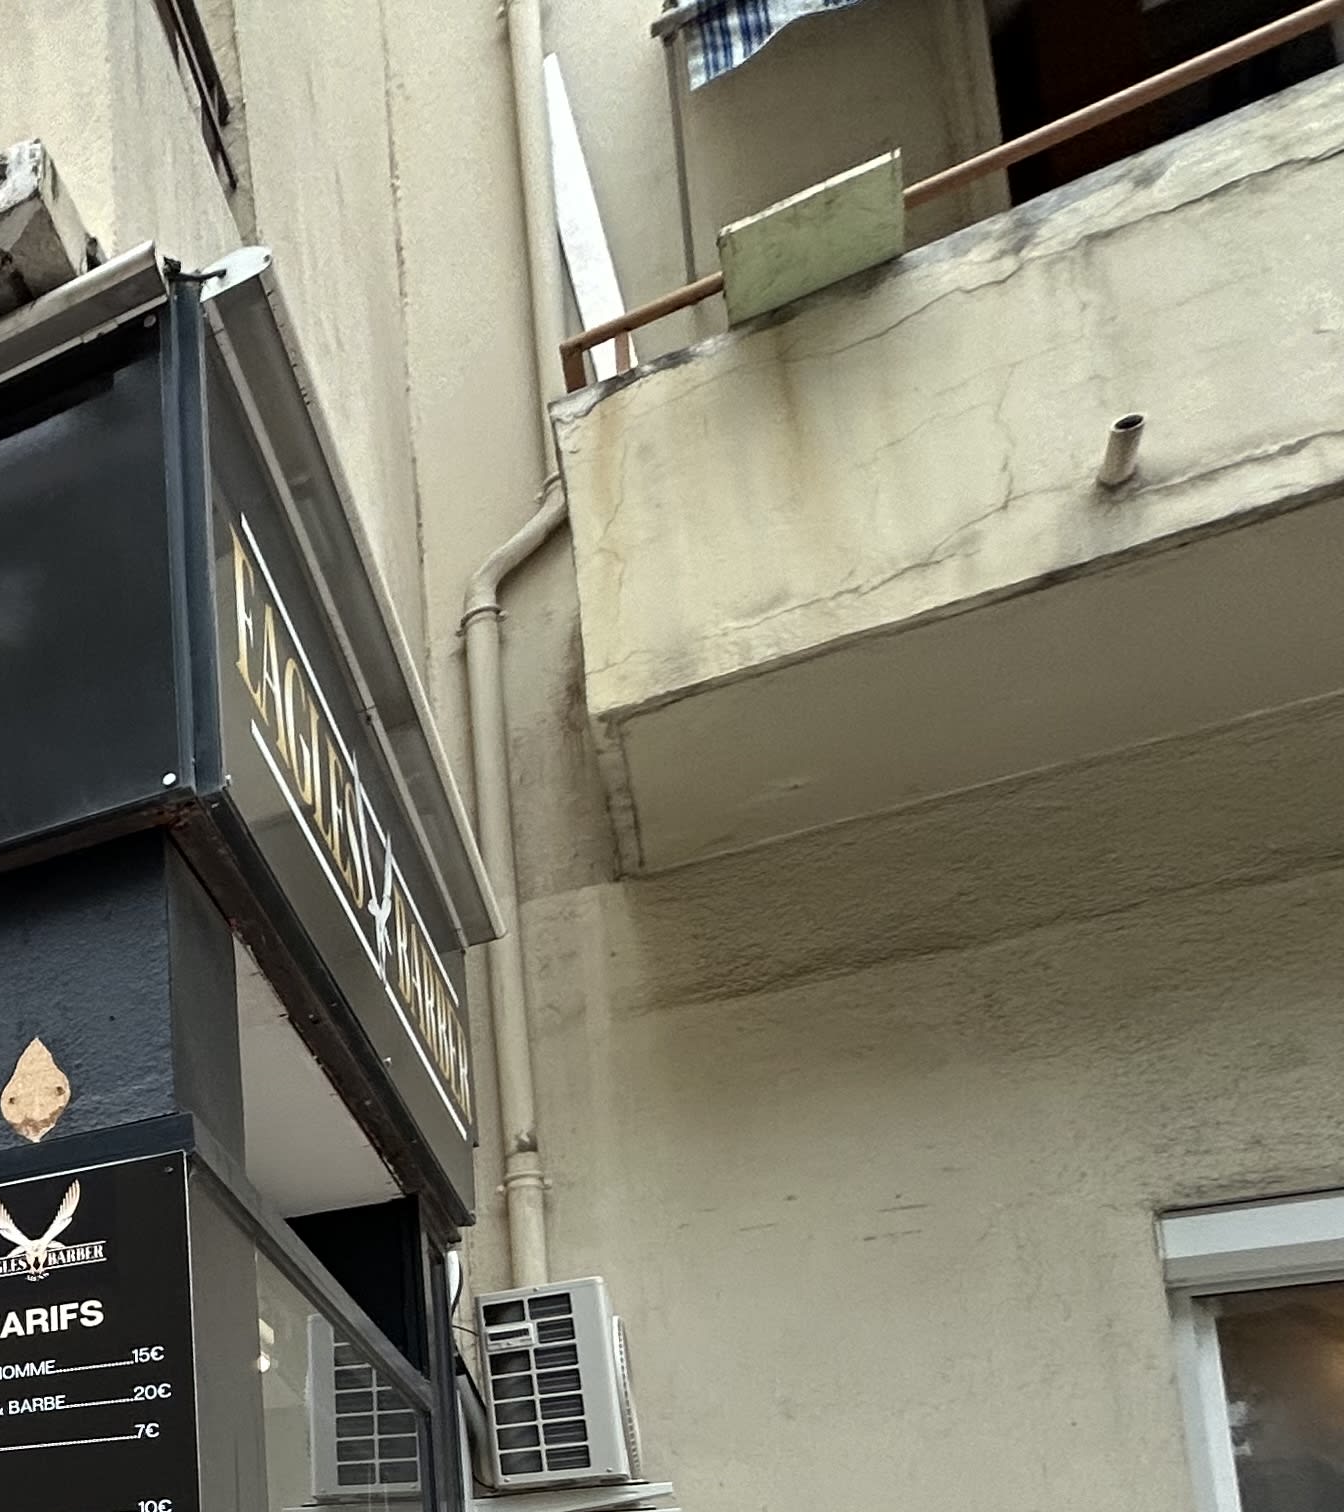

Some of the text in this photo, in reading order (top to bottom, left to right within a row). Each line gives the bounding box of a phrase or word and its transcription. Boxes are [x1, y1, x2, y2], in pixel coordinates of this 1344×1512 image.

[230, 523, 363, 908] EAGLES
[47, 1244, 104, 1266] BARBER
[131, 1345, 165, 1364] 15€
[8, 1394, 67, 1416] BARBE
[133, 1382, 172, 1402] 20€
[134, 1422, 160, 1440] 7€
